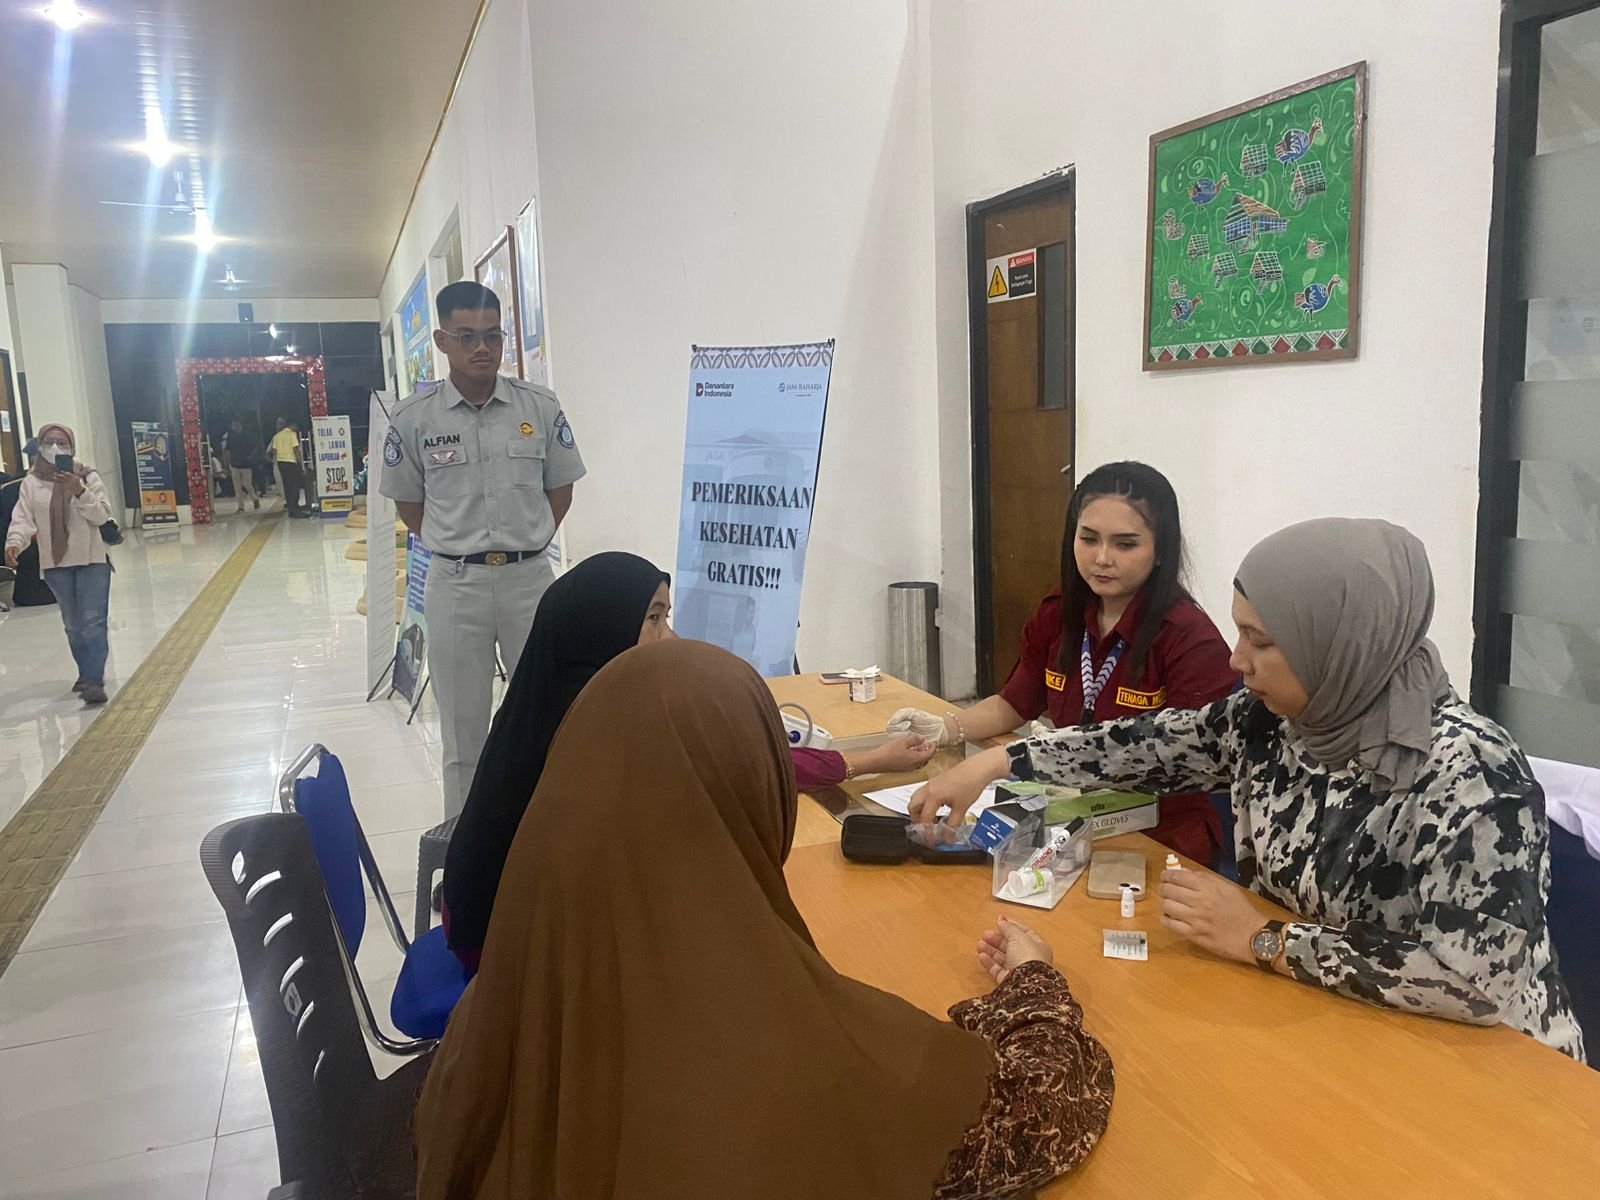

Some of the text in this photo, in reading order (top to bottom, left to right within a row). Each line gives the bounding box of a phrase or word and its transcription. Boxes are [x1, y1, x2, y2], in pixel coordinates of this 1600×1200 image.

[704, 382, 735, 390] Danantara
[423, 434, 461, 449] ALFIAN
[326, 466, 346, 484] STOP
[691, 481, 812, 509] PEMERIKSAAN
[699, 521, 799, 549] KESEHATAN
[707, 560, 781, 590] GRATIS!!!
[1120, 691, 1148, 706] TENAGA
[1101, 814, 1129, 827] GLOVES
